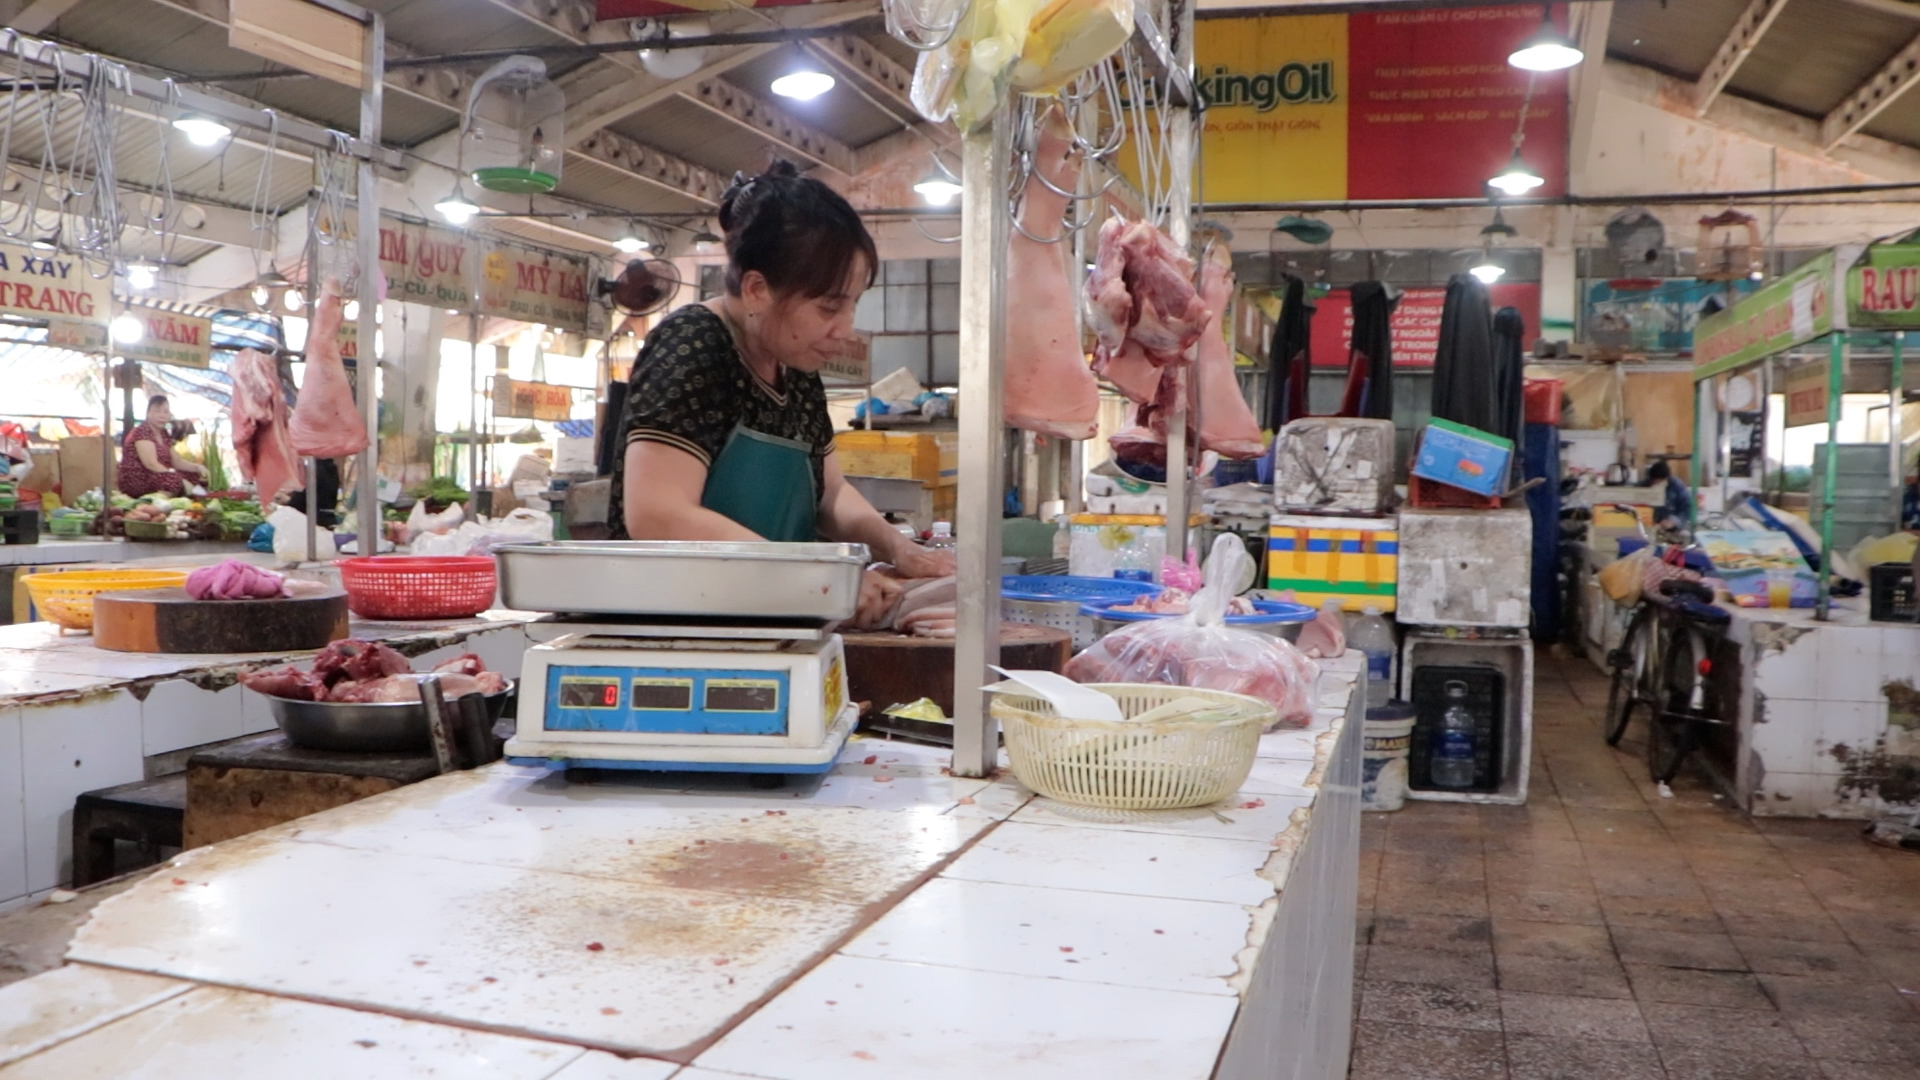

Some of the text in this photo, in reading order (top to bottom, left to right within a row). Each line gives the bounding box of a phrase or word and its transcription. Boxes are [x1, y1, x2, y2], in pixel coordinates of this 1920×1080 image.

[1116, 61, 1334, 111] CokingOil
[379, 228, 409, 265] IM
[1861, 268, 1919, 311] RAU
[604, 685, 618, 705] 0
